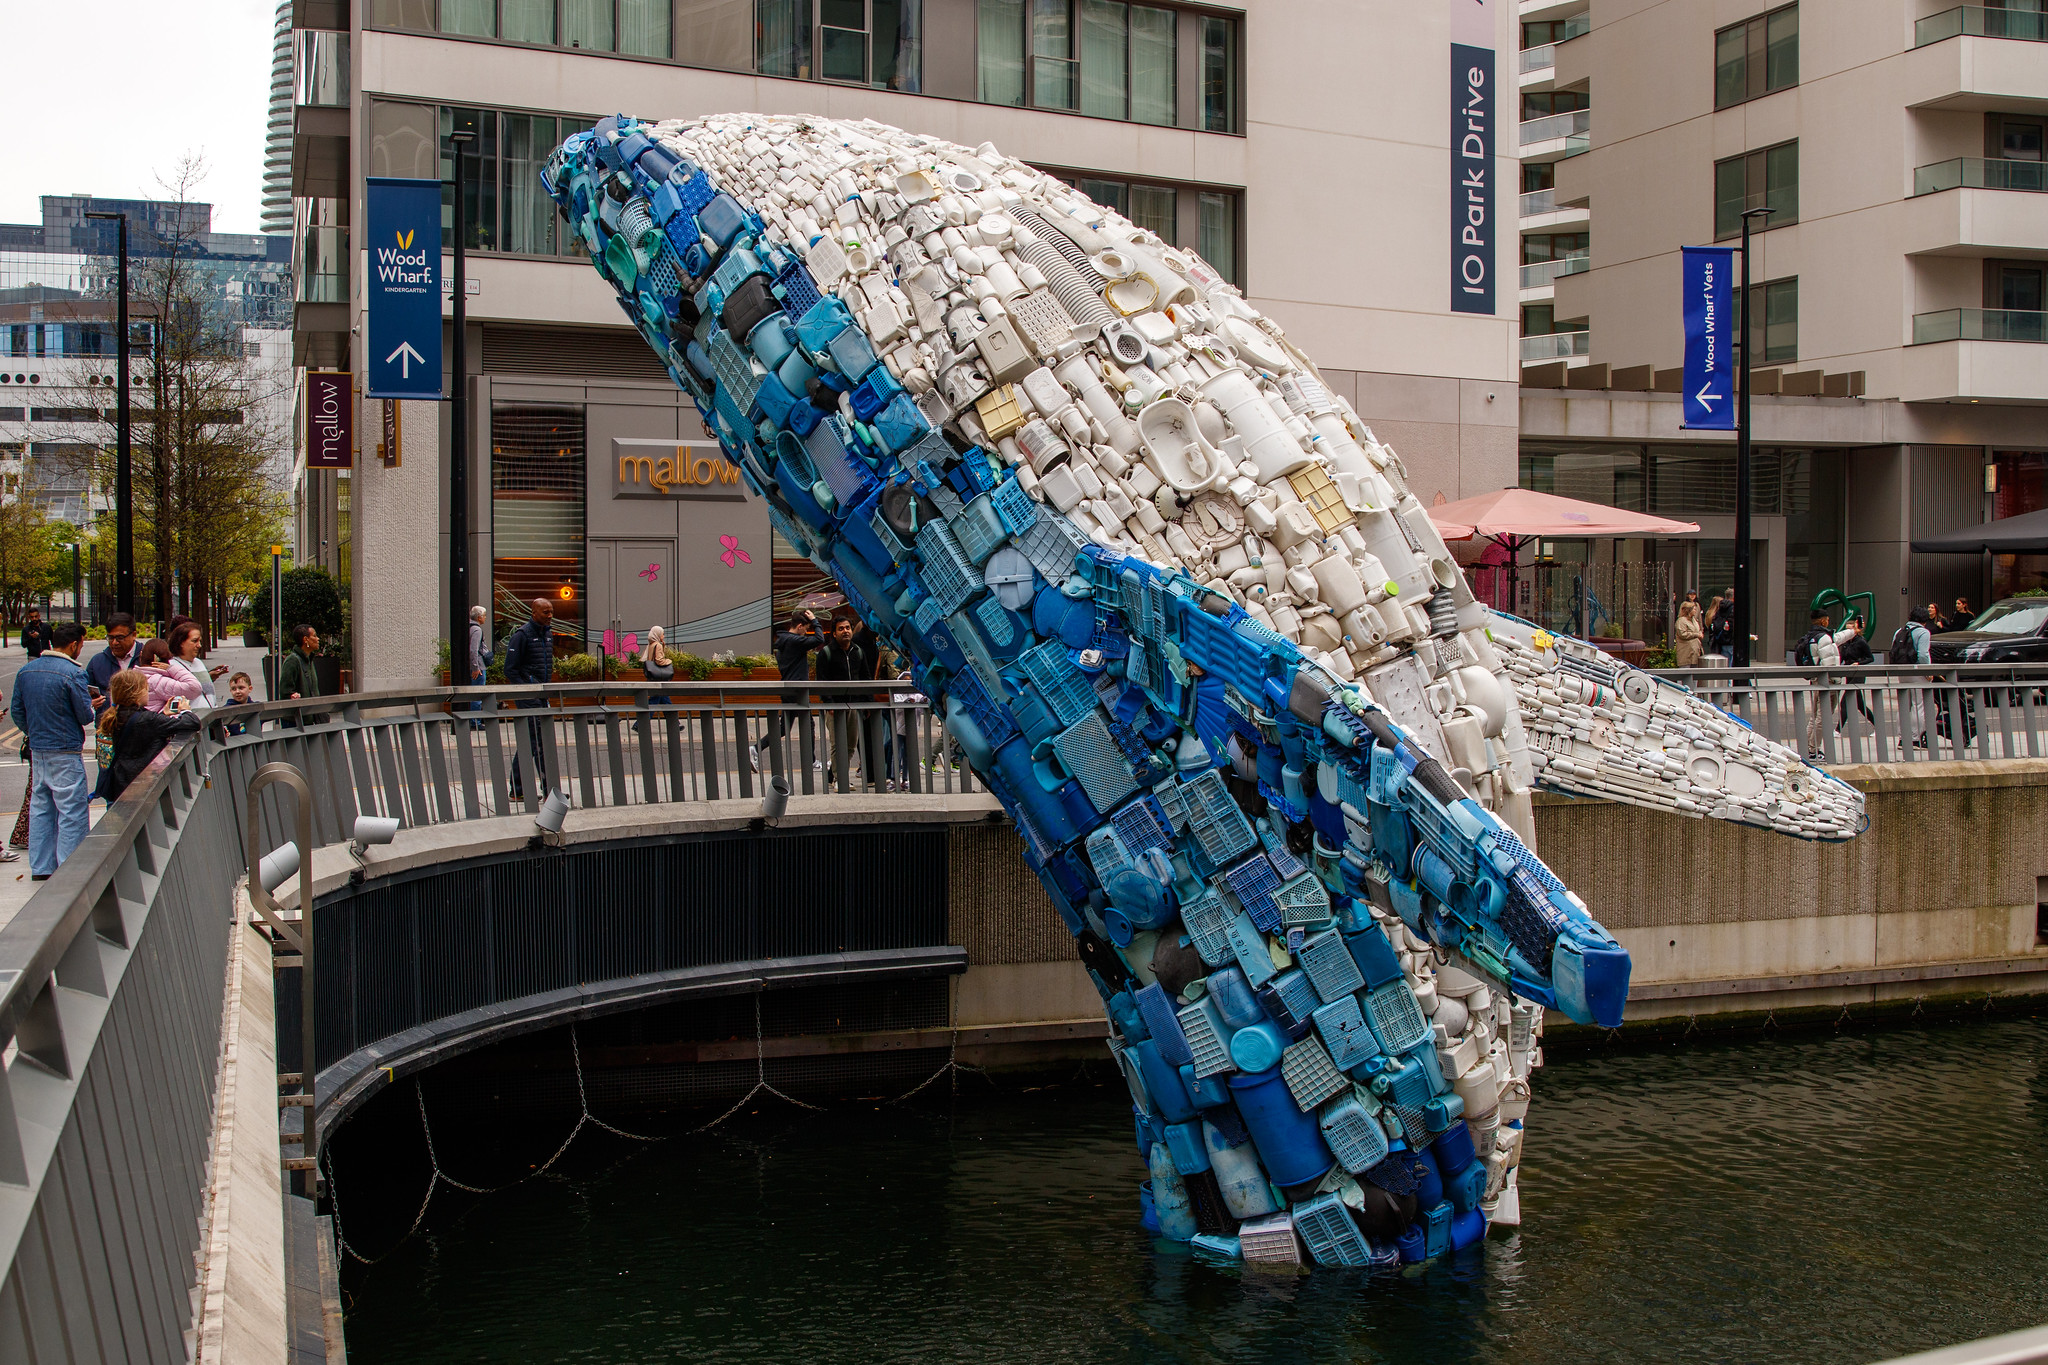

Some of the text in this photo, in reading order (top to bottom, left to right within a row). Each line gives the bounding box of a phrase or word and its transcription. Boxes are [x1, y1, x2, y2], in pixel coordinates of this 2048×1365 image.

[1462, 66, 1485, 294] 10 Park Drive
[377, 247, 426, 266] Wood
[377, 265, 433, 284] Wharf.
[384, 286, 427, 294] KINDERGARTEN
[1703, 262, 1715, 373] Wood Wharf Vets
[315, 381, 345, 460] mallow
[385, 399, 395, 459] mallo
[619, 445, 742, 495] mallow
